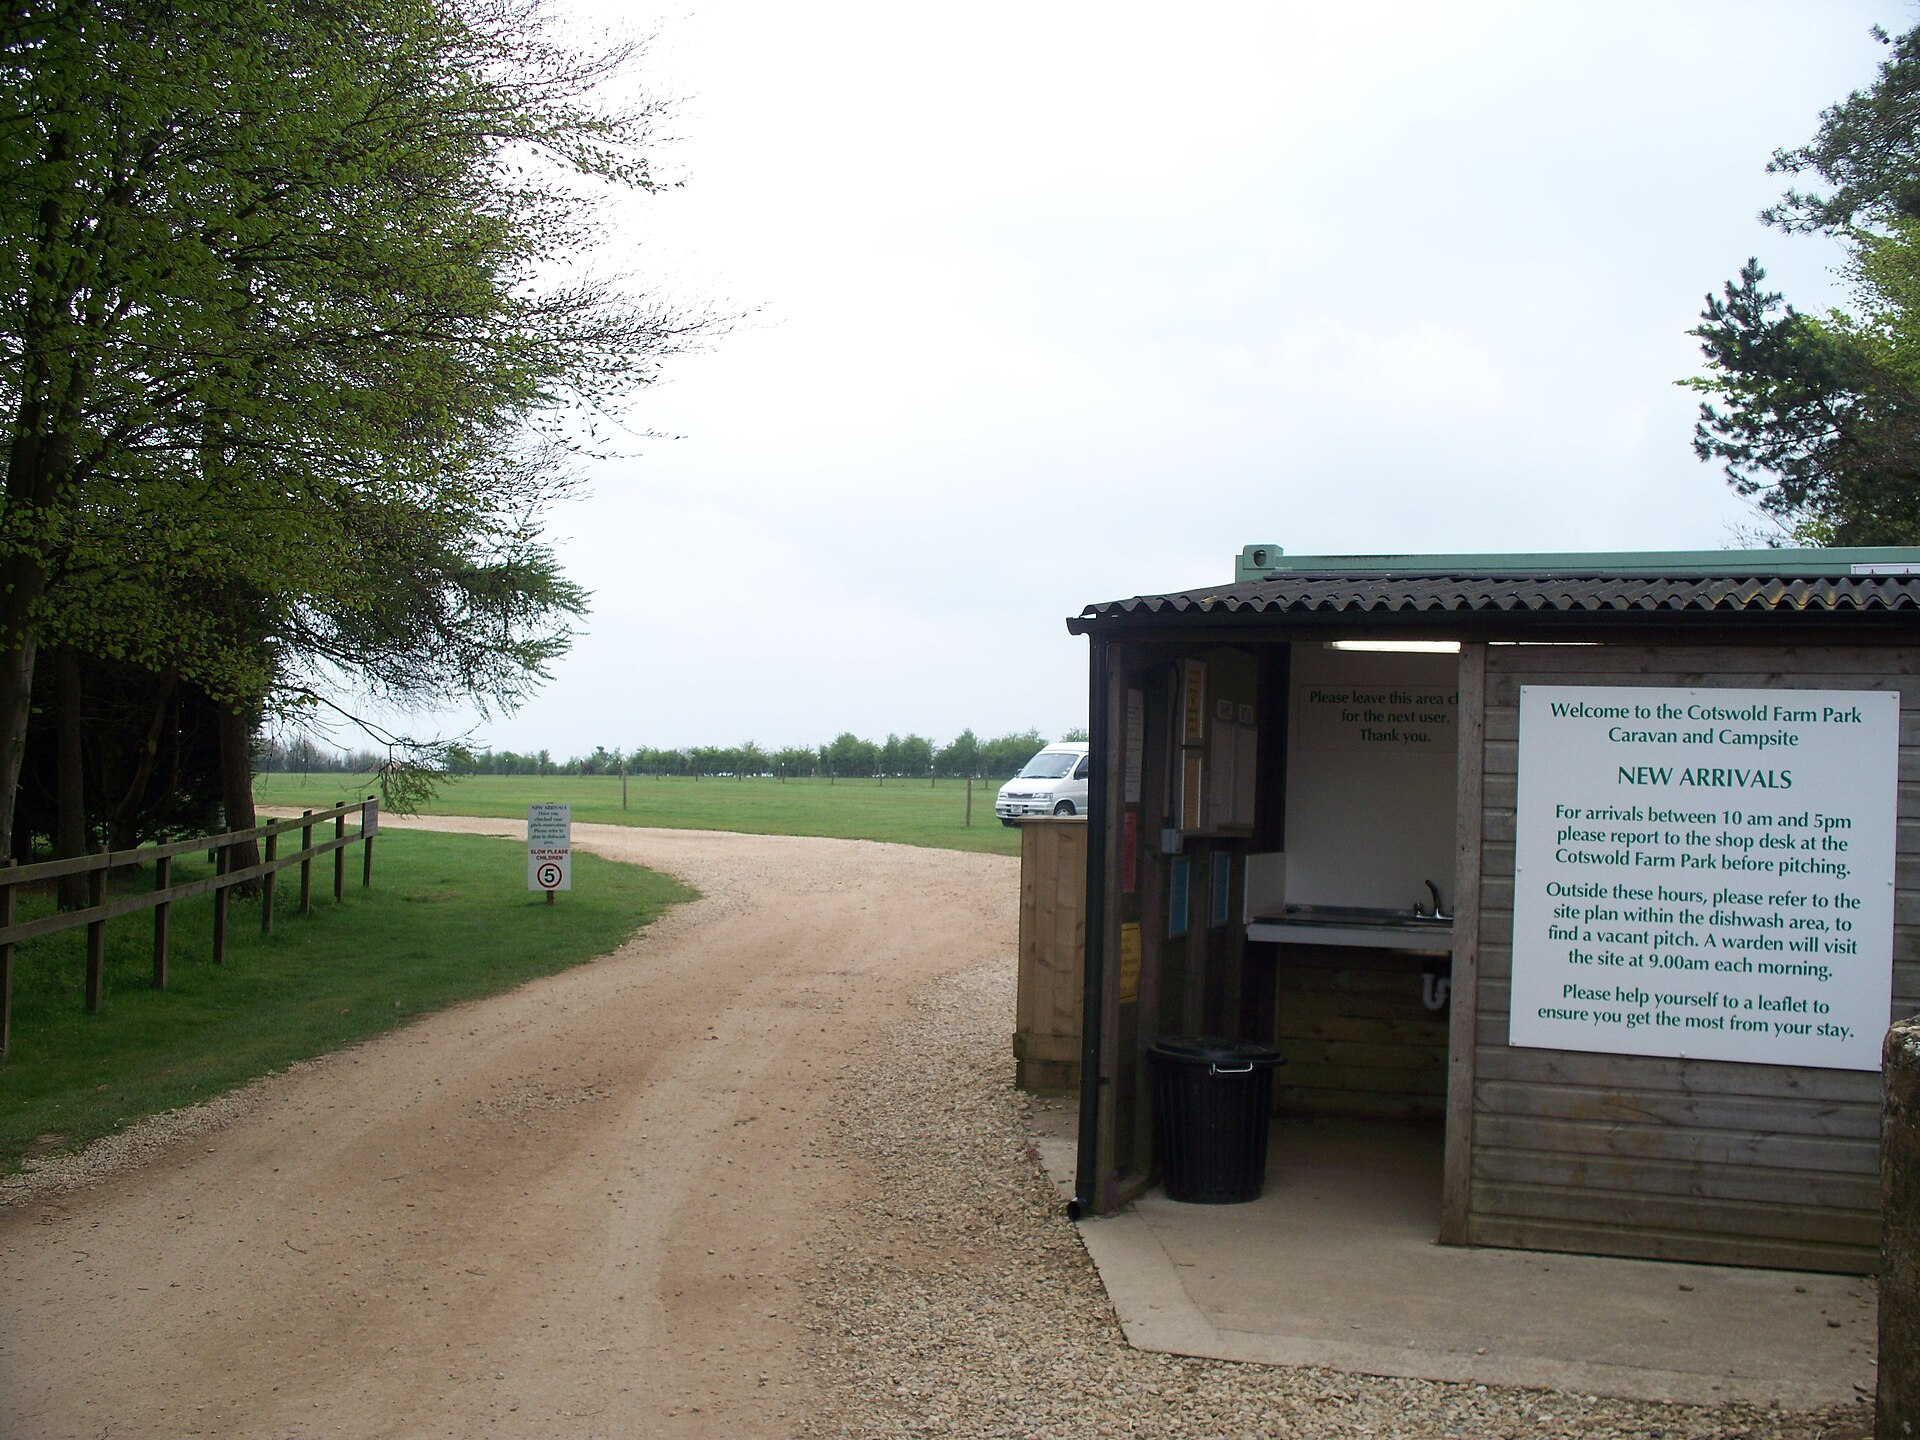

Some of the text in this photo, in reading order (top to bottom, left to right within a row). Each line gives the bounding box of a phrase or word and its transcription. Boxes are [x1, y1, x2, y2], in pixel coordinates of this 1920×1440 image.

[1310, 691, 1348, 703] Please
[1353, 691, 1385, 704] leave
[1390, 692, 1412, 704] this
[1416, 694, 1443, 704] area
[1342, 709, 1450, 723] for the next user.
[1550, 701, 1862, 723] Welcome to the Cotswold Farm Park
[1360, 729, 1431, 745] Thank you.
[1608, 726, 1799, 751] Caravan and Campsite
[1618, 766, 1792, 790] NEW ARRIVALS
[1556, 804, 1851, 834] For arrivals between 10 am and 5pm
[1557, 826, 1848, 853] please report to the shop desk at the
[544, 868, 555, 883] 5
[1555, 848, 1851, 880] Cotswold Farm Park before pitching.
[1546, 881, 1861, 910] Outside these hours, please refer to the
[1553, 905, 1852, 934] site plan within the dishwash area, to
[1548, 924, 1858, 955] find a vacant pitch. A warden will visit
[1568, 948, 1833, 982] the site at 9.00am each morning.
[1563, 983, 1830, 1015] Please help yourself to a leaflet to
[1538, 1007, 1854, 1041] ensure you get the most from your stay.
